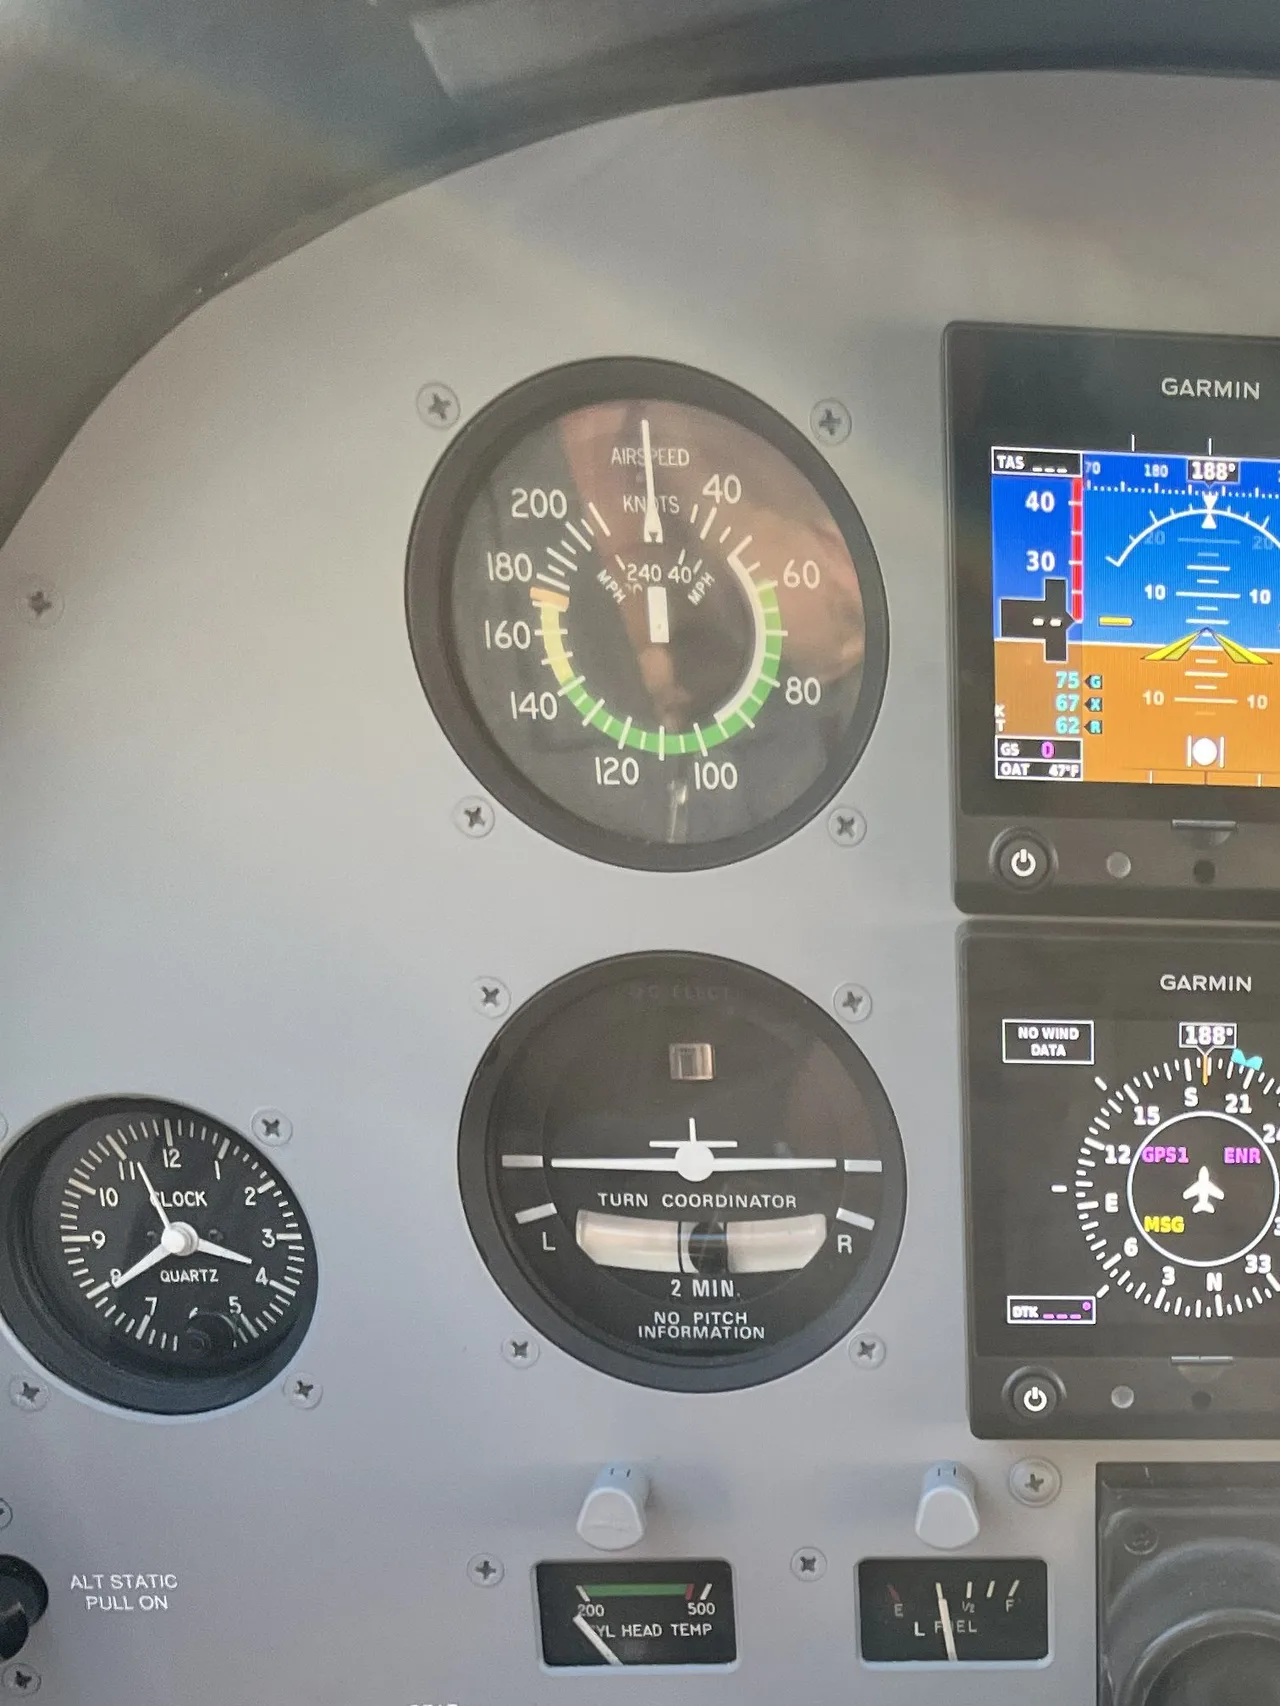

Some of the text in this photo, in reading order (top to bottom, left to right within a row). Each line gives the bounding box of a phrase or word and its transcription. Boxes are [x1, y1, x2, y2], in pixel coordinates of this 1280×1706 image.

[1161, 377, 1261, 401] GARMIN
[997, 455, 1025, 470] TAS
[1144, 463, 1168, 478] 180
[702, 474, 741, 503] 40
[511, 488, 567, 519] 200
[1025, 491, 1055, 512] 40
[487, 553, 533, 582] 180
[1026, 551, 1055, 571] 30
[626, 565, 661, 583] 240
[783, 560, 820, 588] 60
[1144, 584, 1166, 600] 10
[1249, 589, 1271, 604] 10
[485, 620, 531, 649] 160
[1056, 671, 1080, 689] 75
[786, 677, 821, 705] 80
[1143, 690, 1165, 705] 10
[511, 691, 557, 720] 140
[1056, 694, 1080, 712] 67
[1247, 695, 1268, 710] 10
[1055, 716, 1080, 734] 62
[1000, 743, 1020, 756] GS
[595, 757, 640, 785] 120
[694, 763, 737, 790] 100
[1001, 762, 1030, 776] OAT
[1160, 974, 1252, 992] GARMIN
[1017, 1027, 1079, 1040] NO WIND
[1030, 1044, 1066, 1057] DATA
[163, 1149, 182, 1168] 12
[1141, 1147, 1189, 1164] GPS1
[1224, 1147, 1261, 1164] ENR
[100, 1187, 118, 1206] 10
[150, 1190, 208, 1207] CLOCK
[598, 1192, 797, 1208] TURN COORDINATOR
[1144, 1216, 1184, 1233] MSG
[160, 1269, 219, 1283] QUARTZ
[654, 1311, 747, 1324] NO PITCH
[1012, 1305, 1039, 1318] DTK
[638, 1326, 765, 1339] INFORMATION
[71, 1574, 178, 1589] ALT STATIC
[86, 1596, 168, 1611] PULL ON
[621, 1622, 712, 1638] HEAD TEMP
